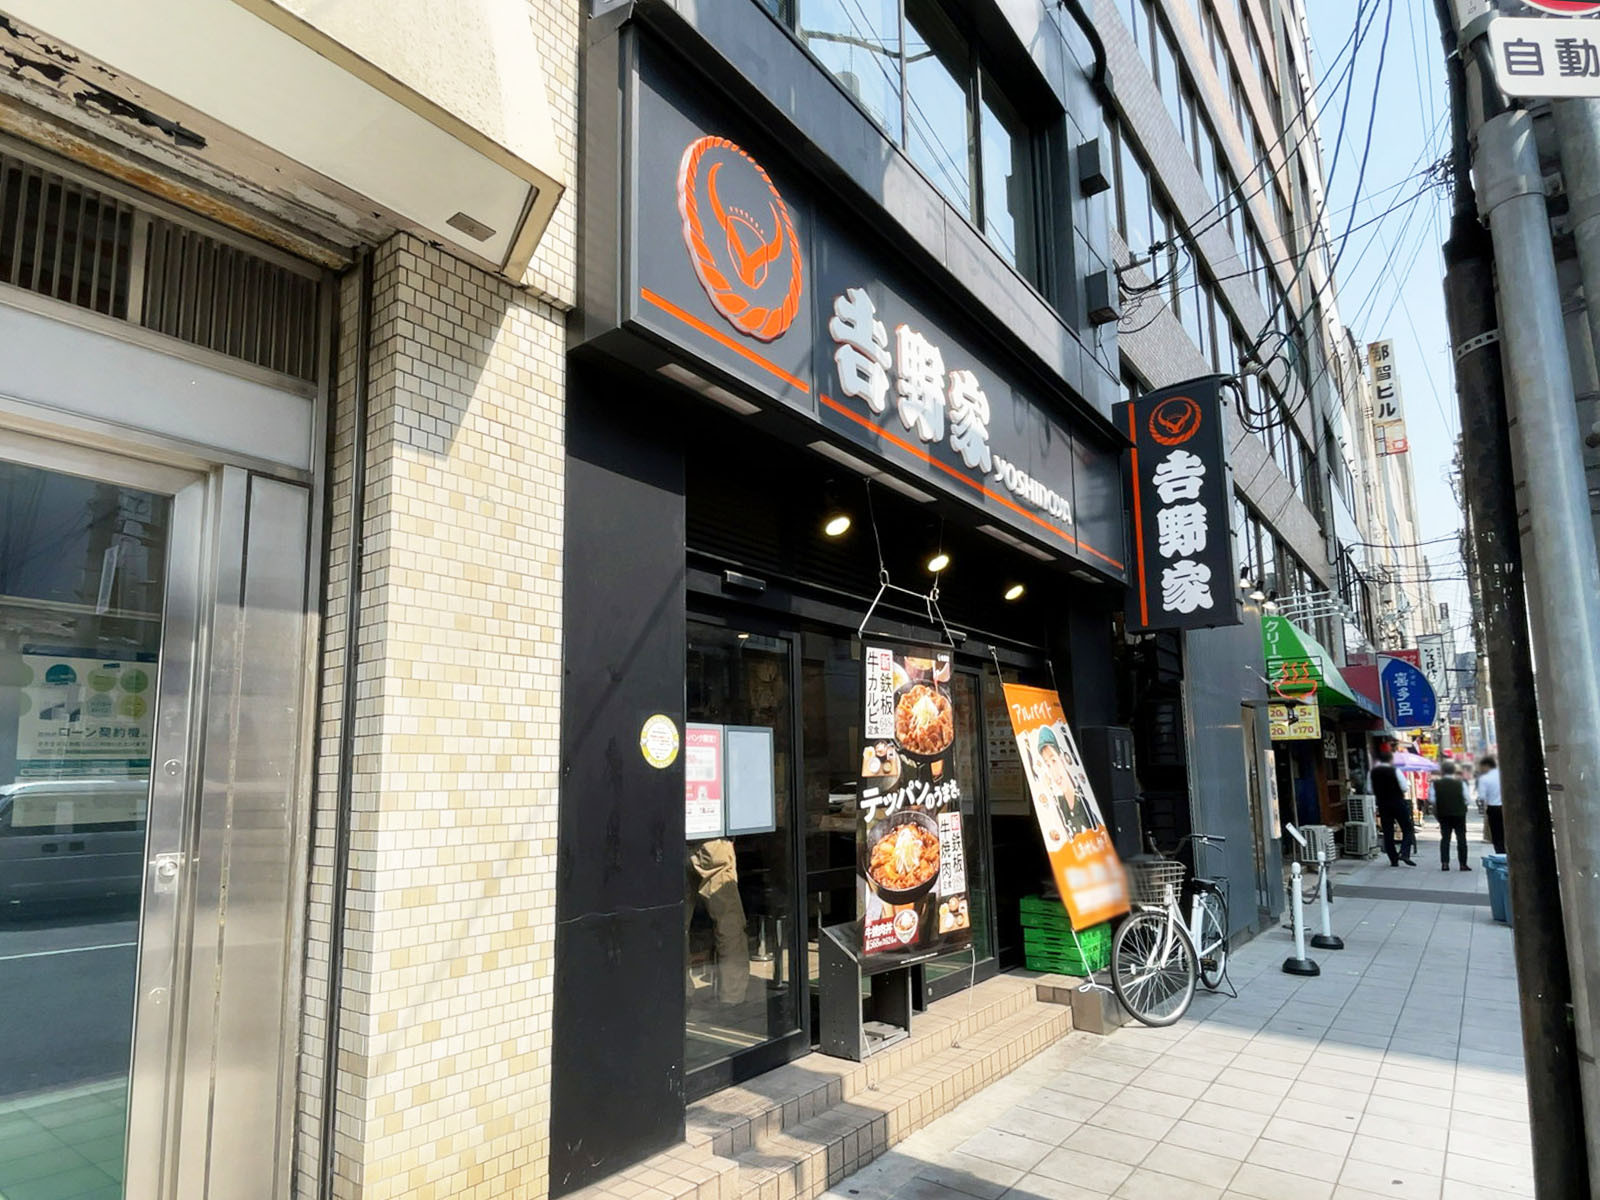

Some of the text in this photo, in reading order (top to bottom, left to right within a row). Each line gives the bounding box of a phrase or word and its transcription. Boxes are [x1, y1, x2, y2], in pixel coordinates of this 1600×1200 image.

[1503, 38, 1600, 77] 自動
[829, 287, 991, 473] 吉野家
[993, 454, 1072, 525] YOSHINOYA
[1152, 450, 1214, 614] 吉野家
[1012, 700, 1053, 724] アルバイト
